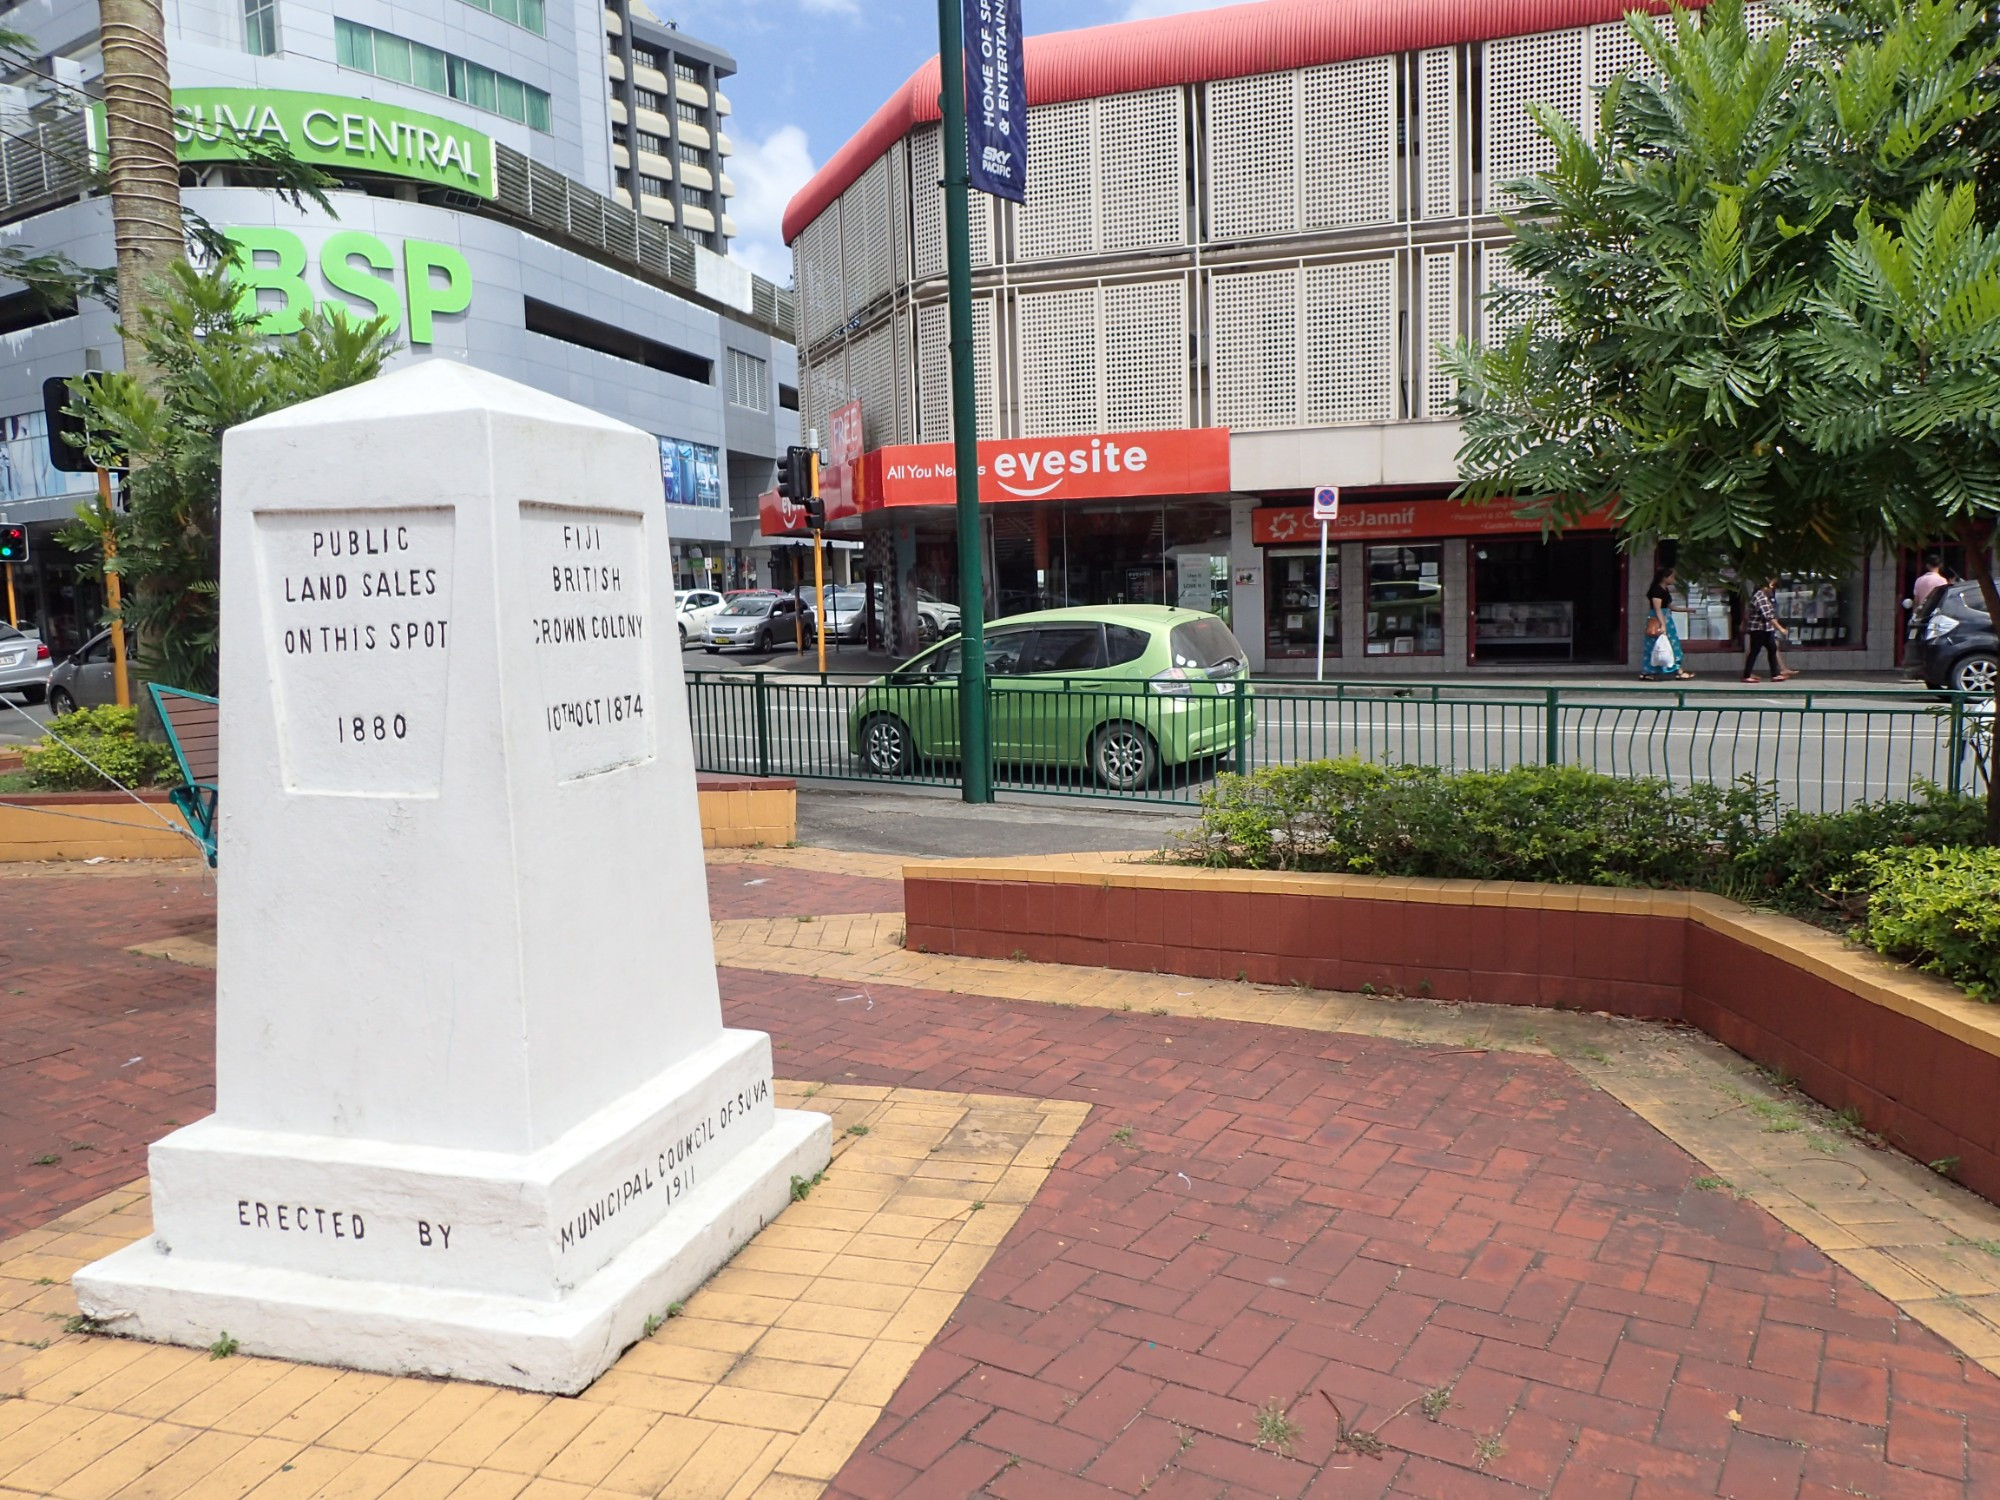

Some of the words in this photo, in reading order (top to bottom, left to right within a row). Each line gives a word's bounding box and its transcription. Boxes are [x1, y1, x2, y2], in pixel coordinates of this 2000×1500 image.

[981, 27, 993, 58] OF
[994, 0, 1010, 112] ENTERTAIN
[982, 63, 995, 127] HOME
[172, 103, 289, 144] SUVA
[302, 109, 480, 179] CENTRAL
[999, 117, 1010, 136] &
[982, 145, 1012, 165] SKY
[982, 159, 1012, 179] PACIFIC
[223, 226, 473, 345] BSP
[886, 465, 905, 480] All
[907, 464, 932, 479] You
[994, 438, 1148, 481] eyesite
[313, 527, 409, 557] PUBLIC
[563, 525, 600, 550] FIJI
[285, 574, 348, 602] LAND
[362, 569, 437, 598] SALES
[552, 566, 621, 593] BRITISH
[284, 628, 312, 654] ON
[320, 625, 376, 653] THIS
[390, 621, 448, 650] SPOT
[592, 615, 643, 640] COLONY
[607, 694, 644, 723] 1874
[338, 714, 407, 743] 1880
[560, 1167, 653, 1253] MUNICIPAL
[658, 1117, 714, 1178] COUNCIL
[720, 1100, 733, 1129] OF
[738, 1079, 768, 1115] SUVA
[666, 1165, 695, 1206] 1911
[238, 1200, 365, 1239] ERECTED
[418, 1220, 451, 1249] BY
